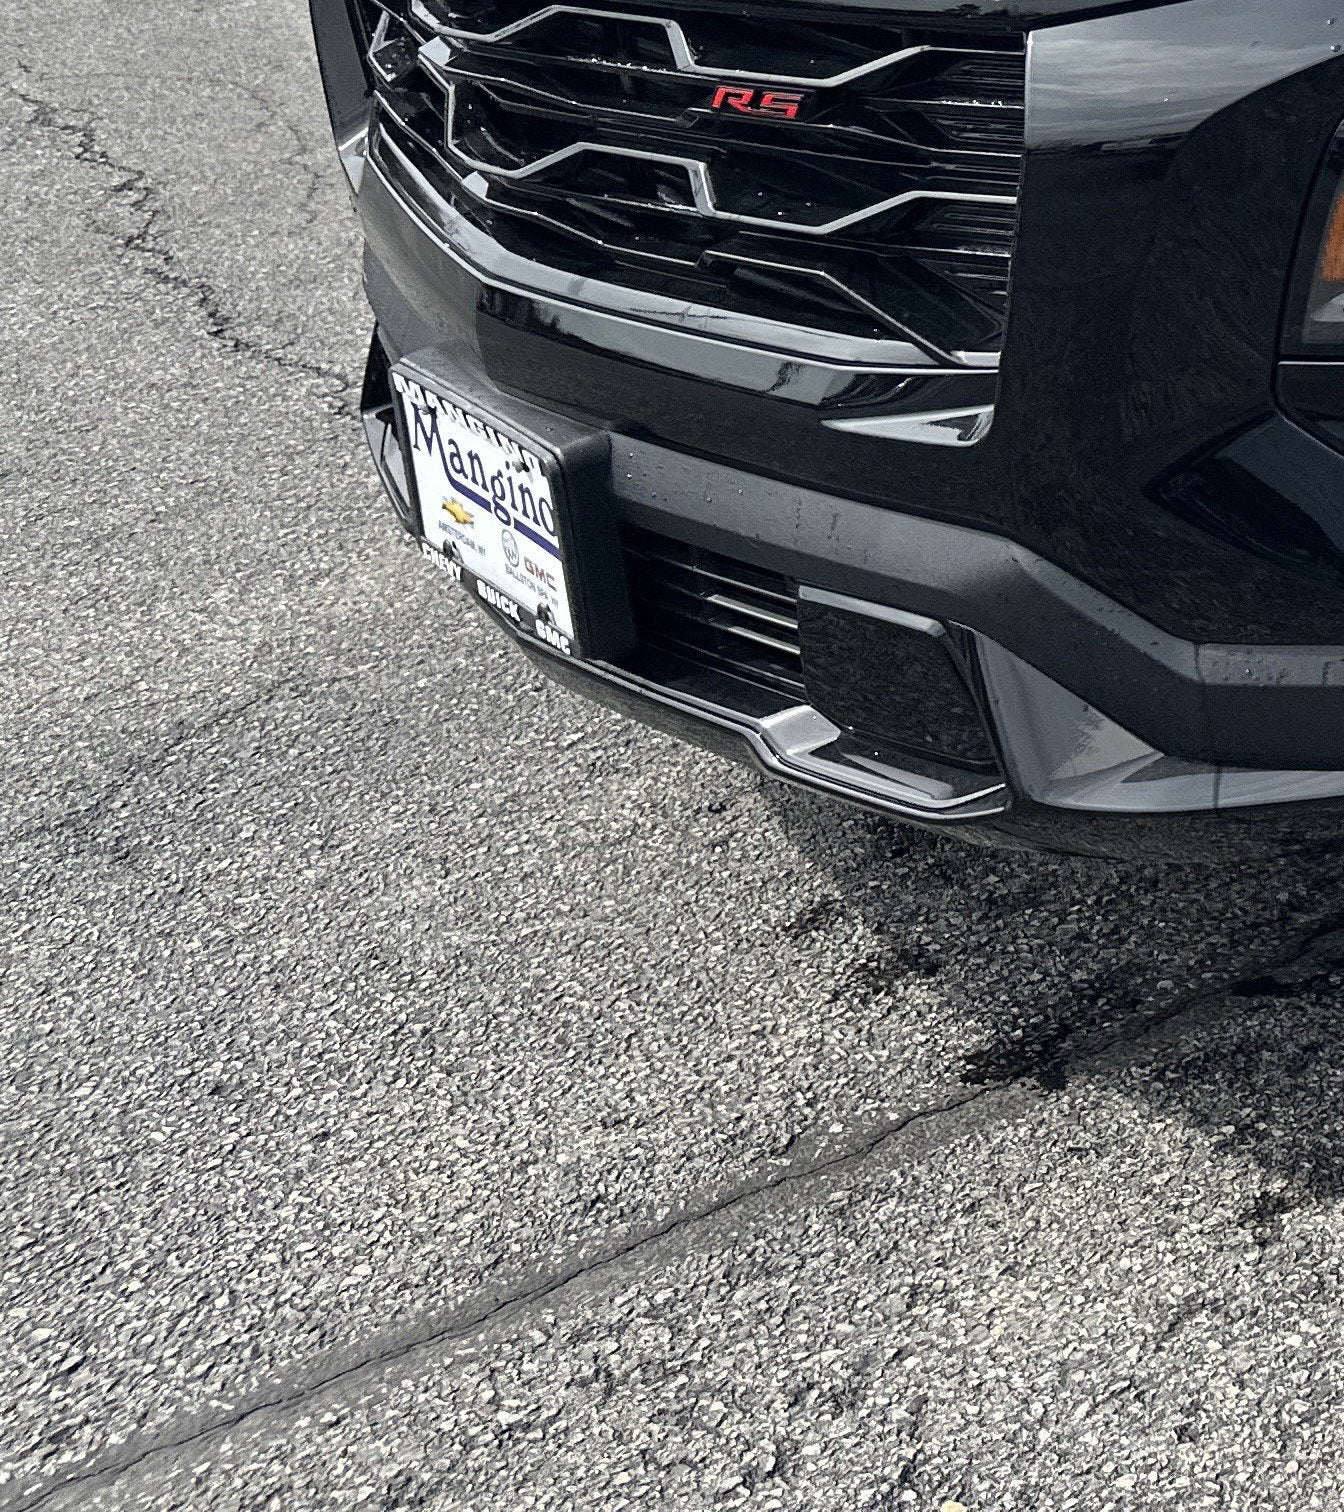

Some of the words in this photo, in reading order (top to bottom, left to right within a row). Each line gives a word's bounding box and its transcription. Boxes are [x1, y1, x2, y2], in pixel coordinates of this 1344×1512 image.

[711, 85, 804, 120] RS
[391, 370, 543, 476] MANGINO
[411, 399, 558, 538] Mangino
[422, 542, 461, 582] CHEVY
[476, 579, 521, 622] BUICK
[535, 619, 571, 655] GMC
[523, 555, 557, 592] GMC
